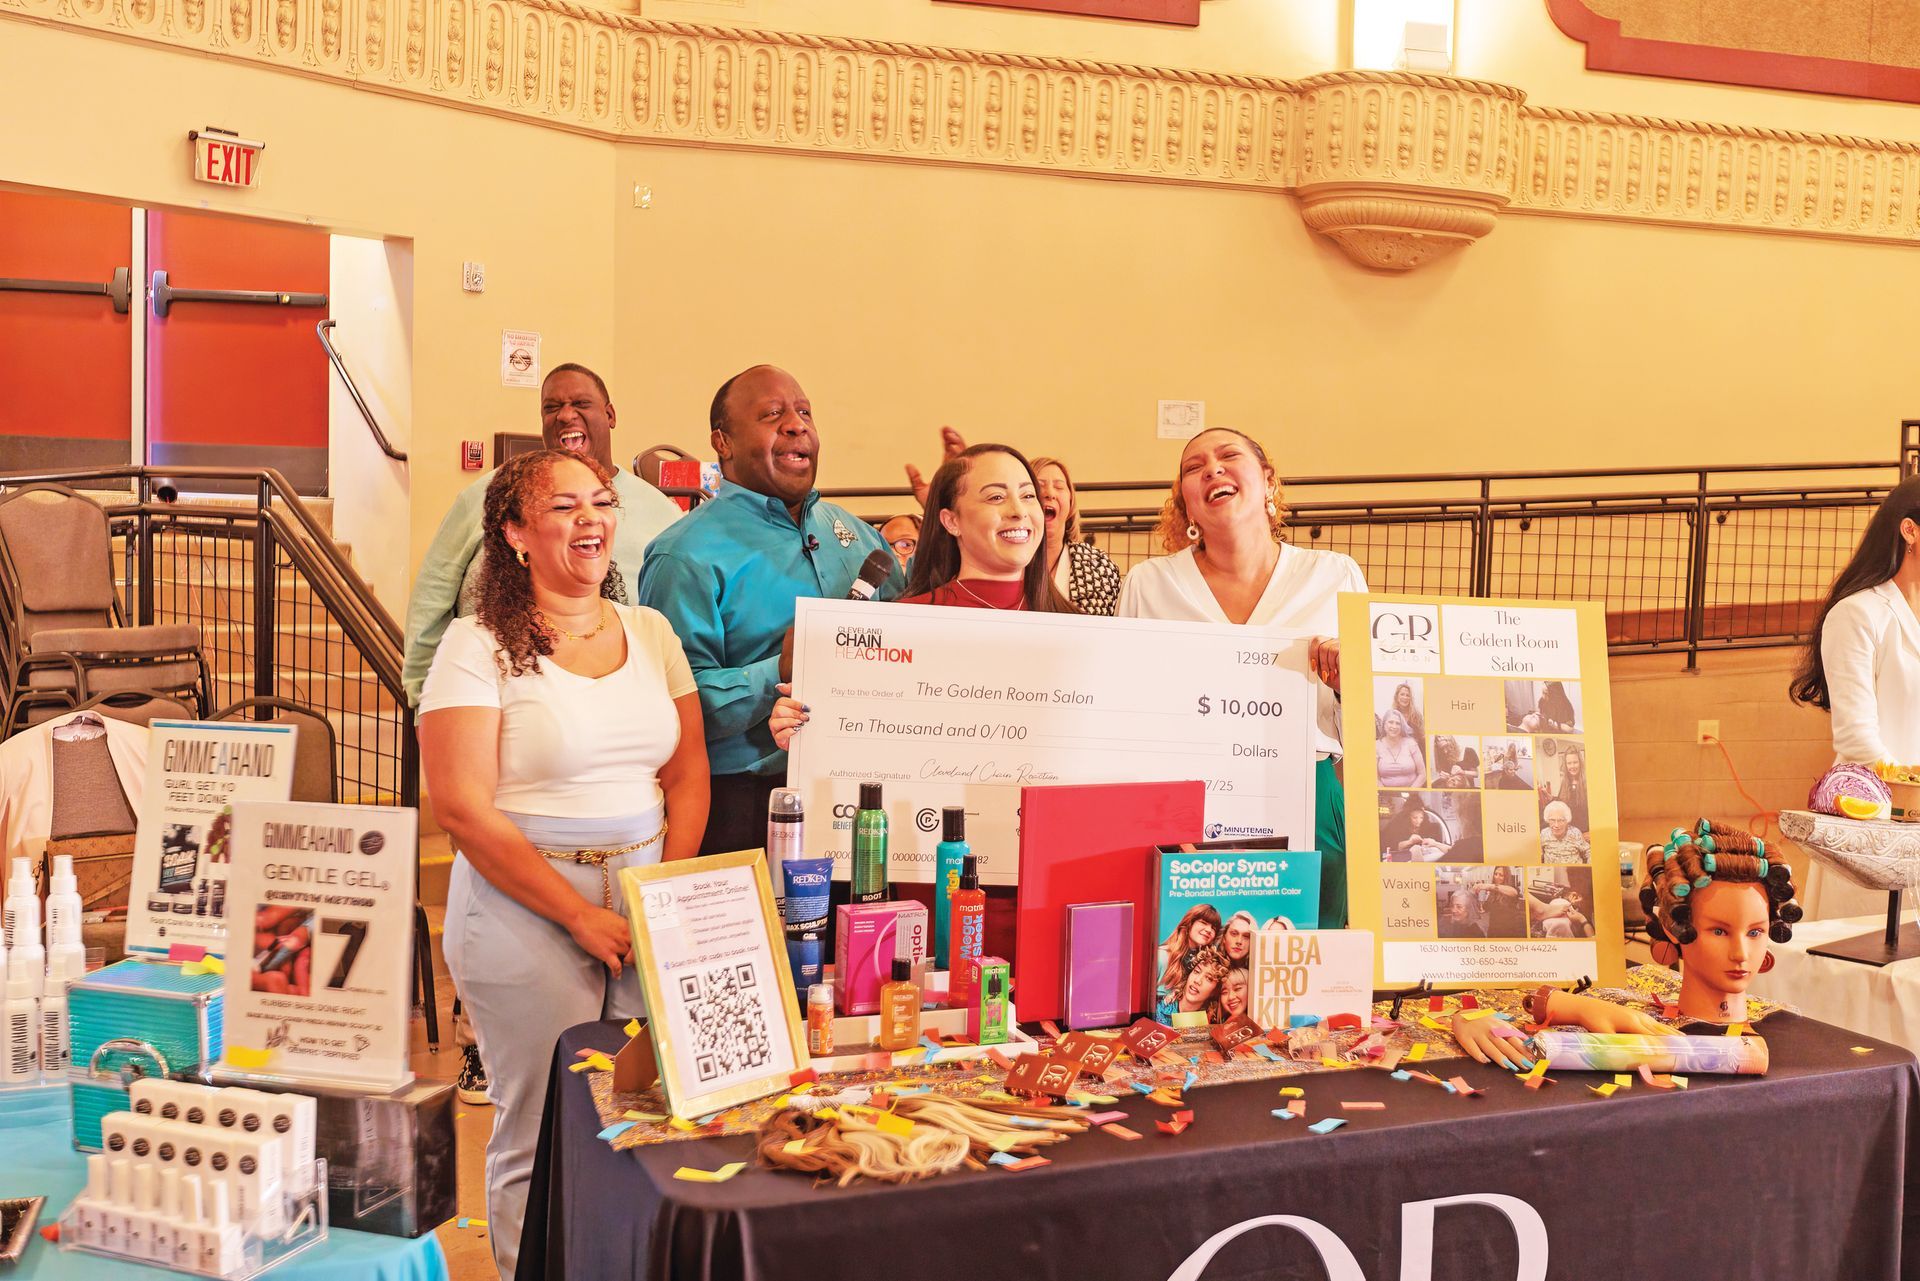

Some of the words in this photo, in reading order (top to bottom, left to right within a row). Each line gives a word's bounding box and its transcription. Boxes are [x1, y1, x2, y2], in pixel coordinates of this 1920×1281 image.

[207, 143, 255, 185] EXIT
[1494, 610, 1521, 626] The
[837, 626, 883, 635] CLEVELAND
[1372, 613, 1439, 654] GR
[835, 632, 882, 648] CHAIN
[1459, 632, 1512, 648] Golden
[1516, 634, 1558, 649] Room
[835, 646, 913, 663] REACTION
[1236, 651, 1279, 666] 12987
[1491, 656, 1534, 672] Salon
[831, 687, 846, 697] Pay
[847, 688, 855, 696] to
[857, 688, 870, 696] the
[871, 689, 894, 697] Order
[896, 690, 904, 698] of
[916, 682, 943, 697] The
[947, 683, 1002, 700] Golden
[1006, 687, 1048, 702] Room
[1052, 689, 1094, 704] Salon
[1197, 694, 1211, 716] $
[1220, 698, 1283, 718] 10,000
[1451, 700, 1475, 711] Hair
[838, 717, 863, 732] Ten
[868, 718, 943, 736] Thousand
[946, 721, 976, 738] and
[980, 723, 1028, 740] 0/100
[164, 739, 275, 777] GIMMEAHAND
[1232, 743, 1278, 758] Dollars
[829, 769, 872, 778] Authorized
[874, 771, 911, 781] Signature
[919, 758, 979, 782] Cleveland
[979, 761, 1012, 782] Chain
[1017, 763, 1060, 784] Reaction
[196, 781, 216, 791] GET
[169, 792, 195, 802] FEET
[198, 794, 228, 804] DONE
[1224, 826, 1274, 834] MINUTEMEN
[1497, 822, 1527, 833] Nails
[264, 863, 338, 884] GENTLE
[1170, 858, 1235, 874] SoColor
[1238, 859, 1277, 876] Sync
[1279, 861, 1288, 871] +
[792, 874, 827, 884] REDKEN
[1169, 874, 1216, 890] Tonal
[1218, 873, 1279, 888] Control
[1382, 878, 1430, 892] Waxing
[862, 892, 882, 902] ROOT
[1169, 889, 1215, 898] Pre-Bonded
[1216, 888, 1280, 897] Demi-Permanent
[1281, 888, 1302, 896] Color
[960, 904, 984, 912] matrix
[1401, 898, 1410, 909] &
[1387, 916, 1430, 928] Lashes
[803, 932, 818, 940] GEL
[911, 924, 923, 956] opti
[320, 917, 368, 989] 7
[1260, 934, 1321, 966] LLBA
[1420, 944, 1440, 952] 1630
[1441, 944, 1472, 952] Norton
[1489, 944, 1512, 954] Stow,
[1514, 944, 1530, 952] OH
[1531, 944, 1558, 952] 44224
[1460, 957, 1518, 966] 330-650-4352
[1259, 966, 1309, 996] PRO
[1421, 970, 1558, 982] www.thegoldenroomsalon.com
[1258, 997, 1294, 1027] KIT
[1140, 1031, 1168, 1051] 30
[1227, 1026, 1254, 1043] 30
[1083, 1044, 1110, 1068] 30
[1041, 1064, 1068, 1089] 30
